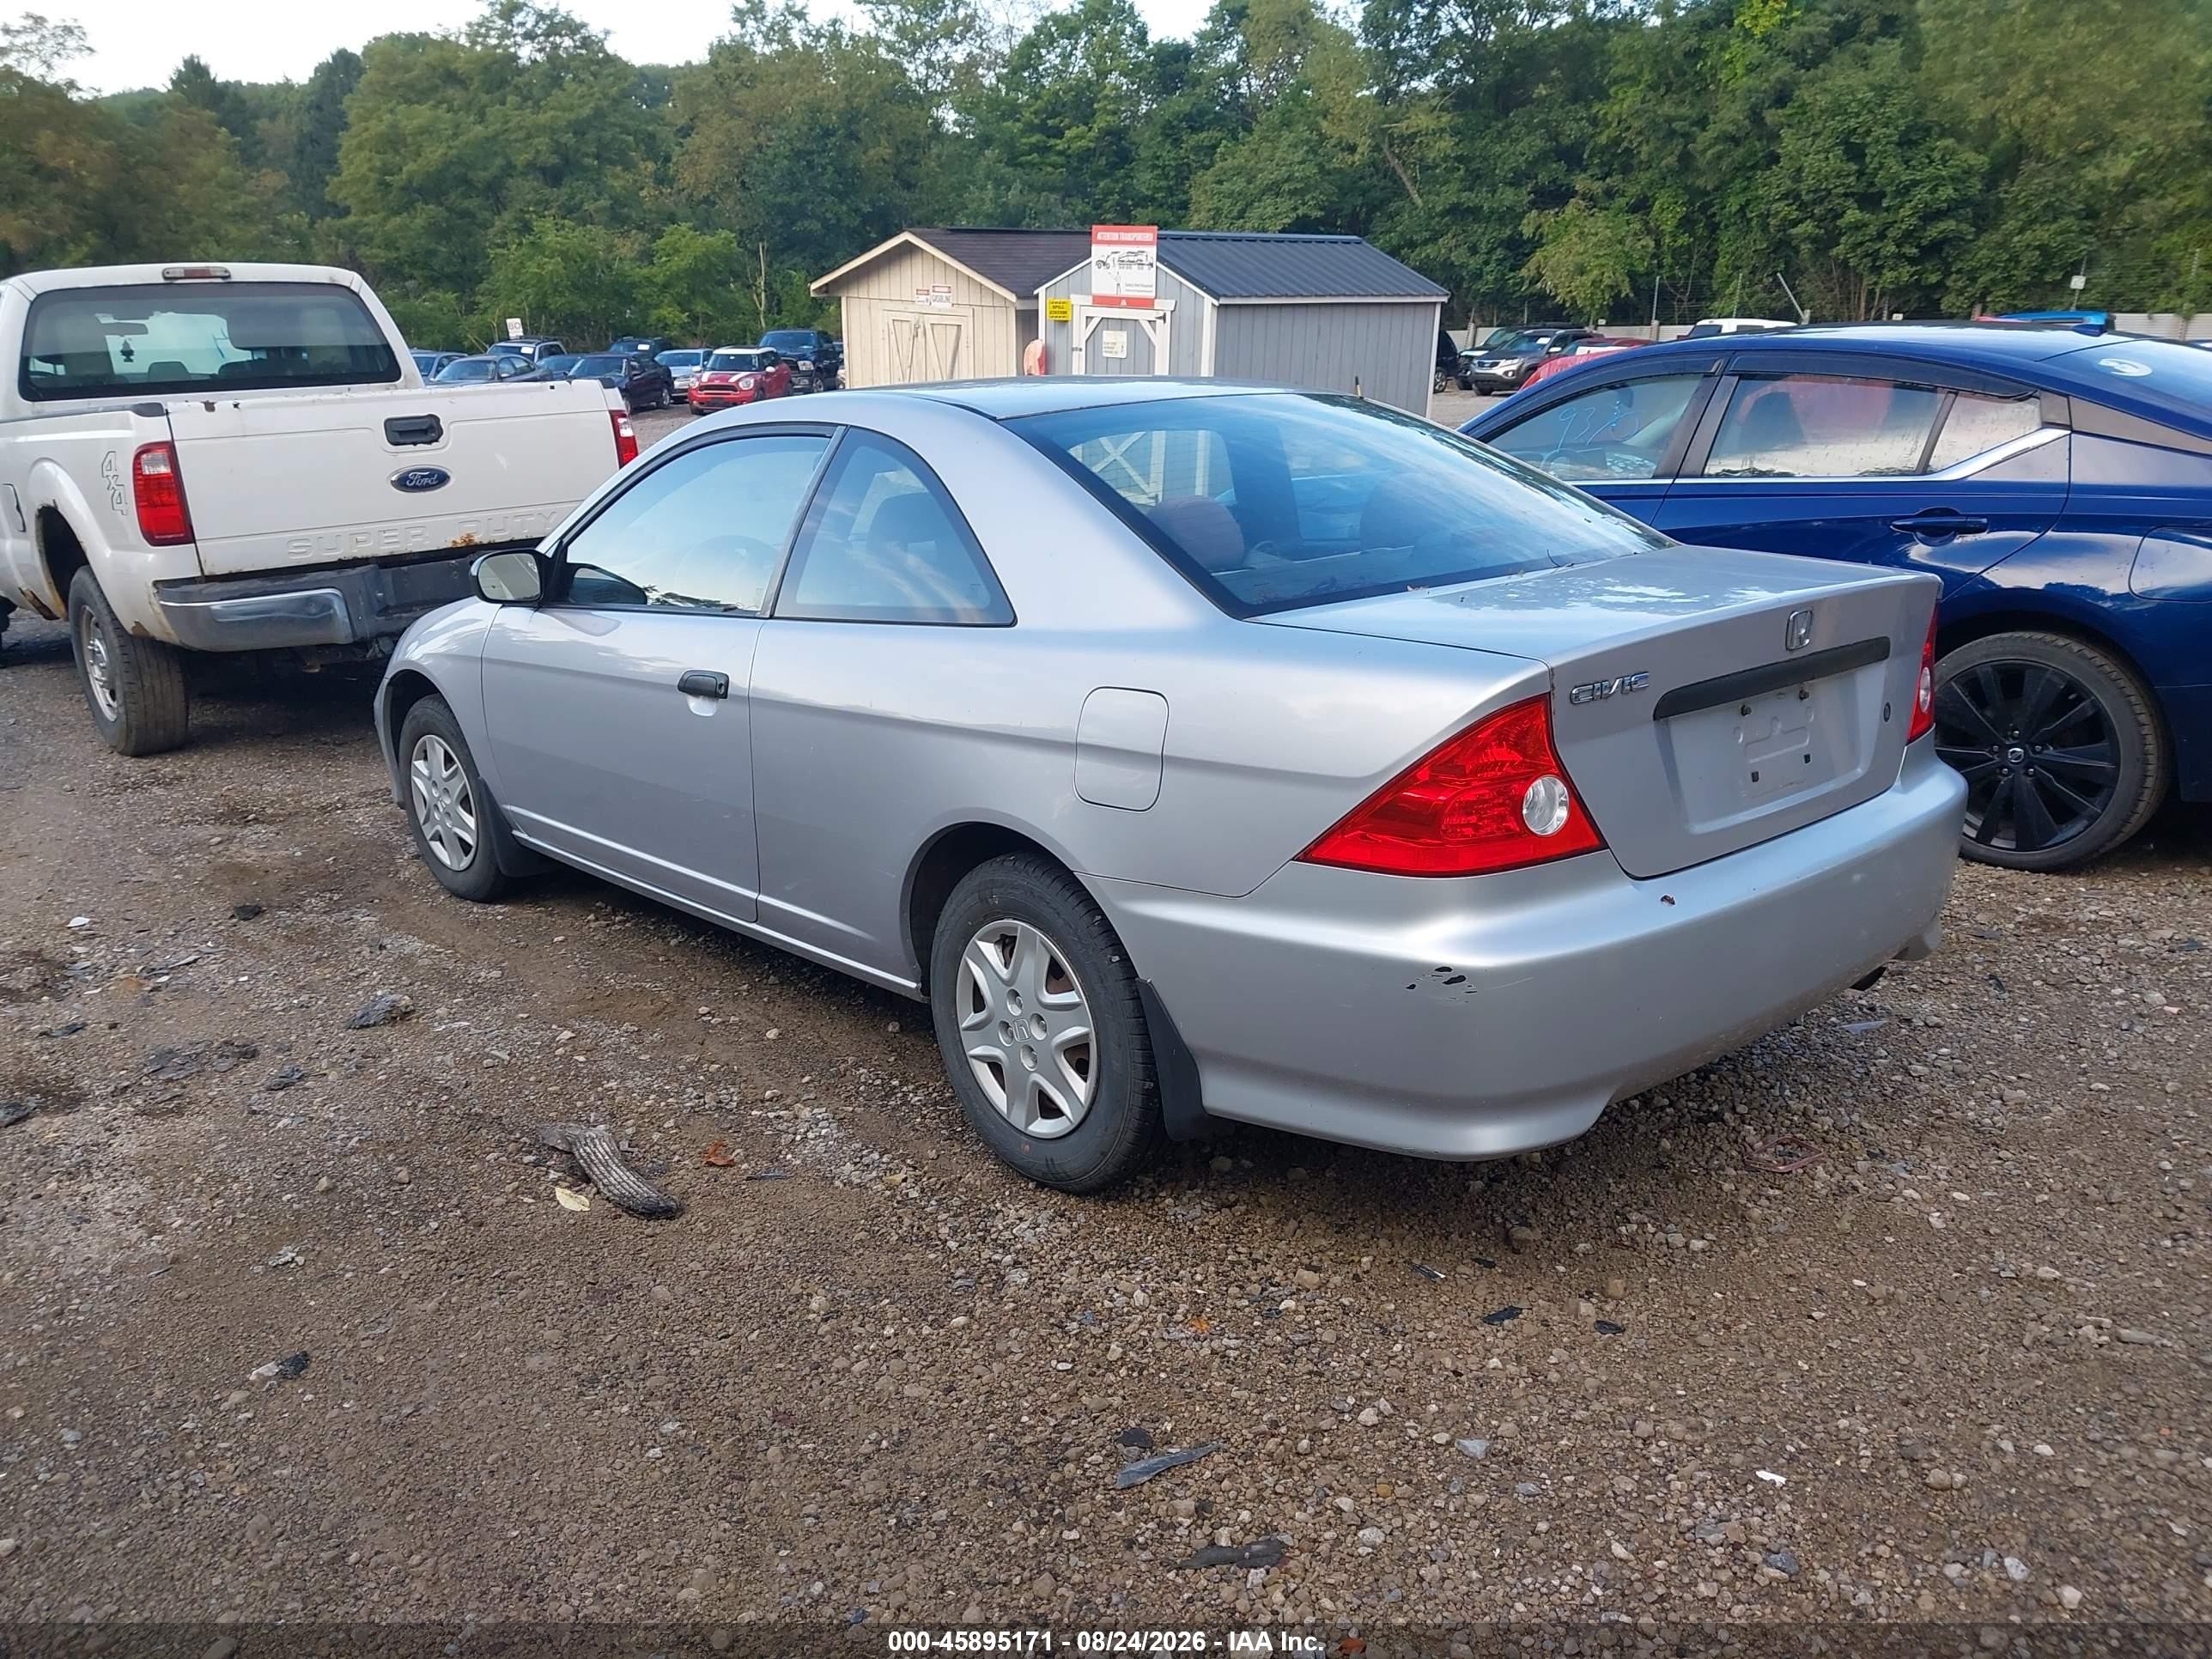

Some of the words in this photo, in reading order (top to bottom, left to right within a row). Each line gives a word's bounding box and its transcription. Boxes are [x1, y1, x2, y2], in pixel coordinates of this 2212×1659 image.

[406, 471, 439, 487] Ford
[287, 526, 429, 559] SUPER
[455, 511, 557, 545] DUTY
[1571, 672, 1650, 704] CIVIC
